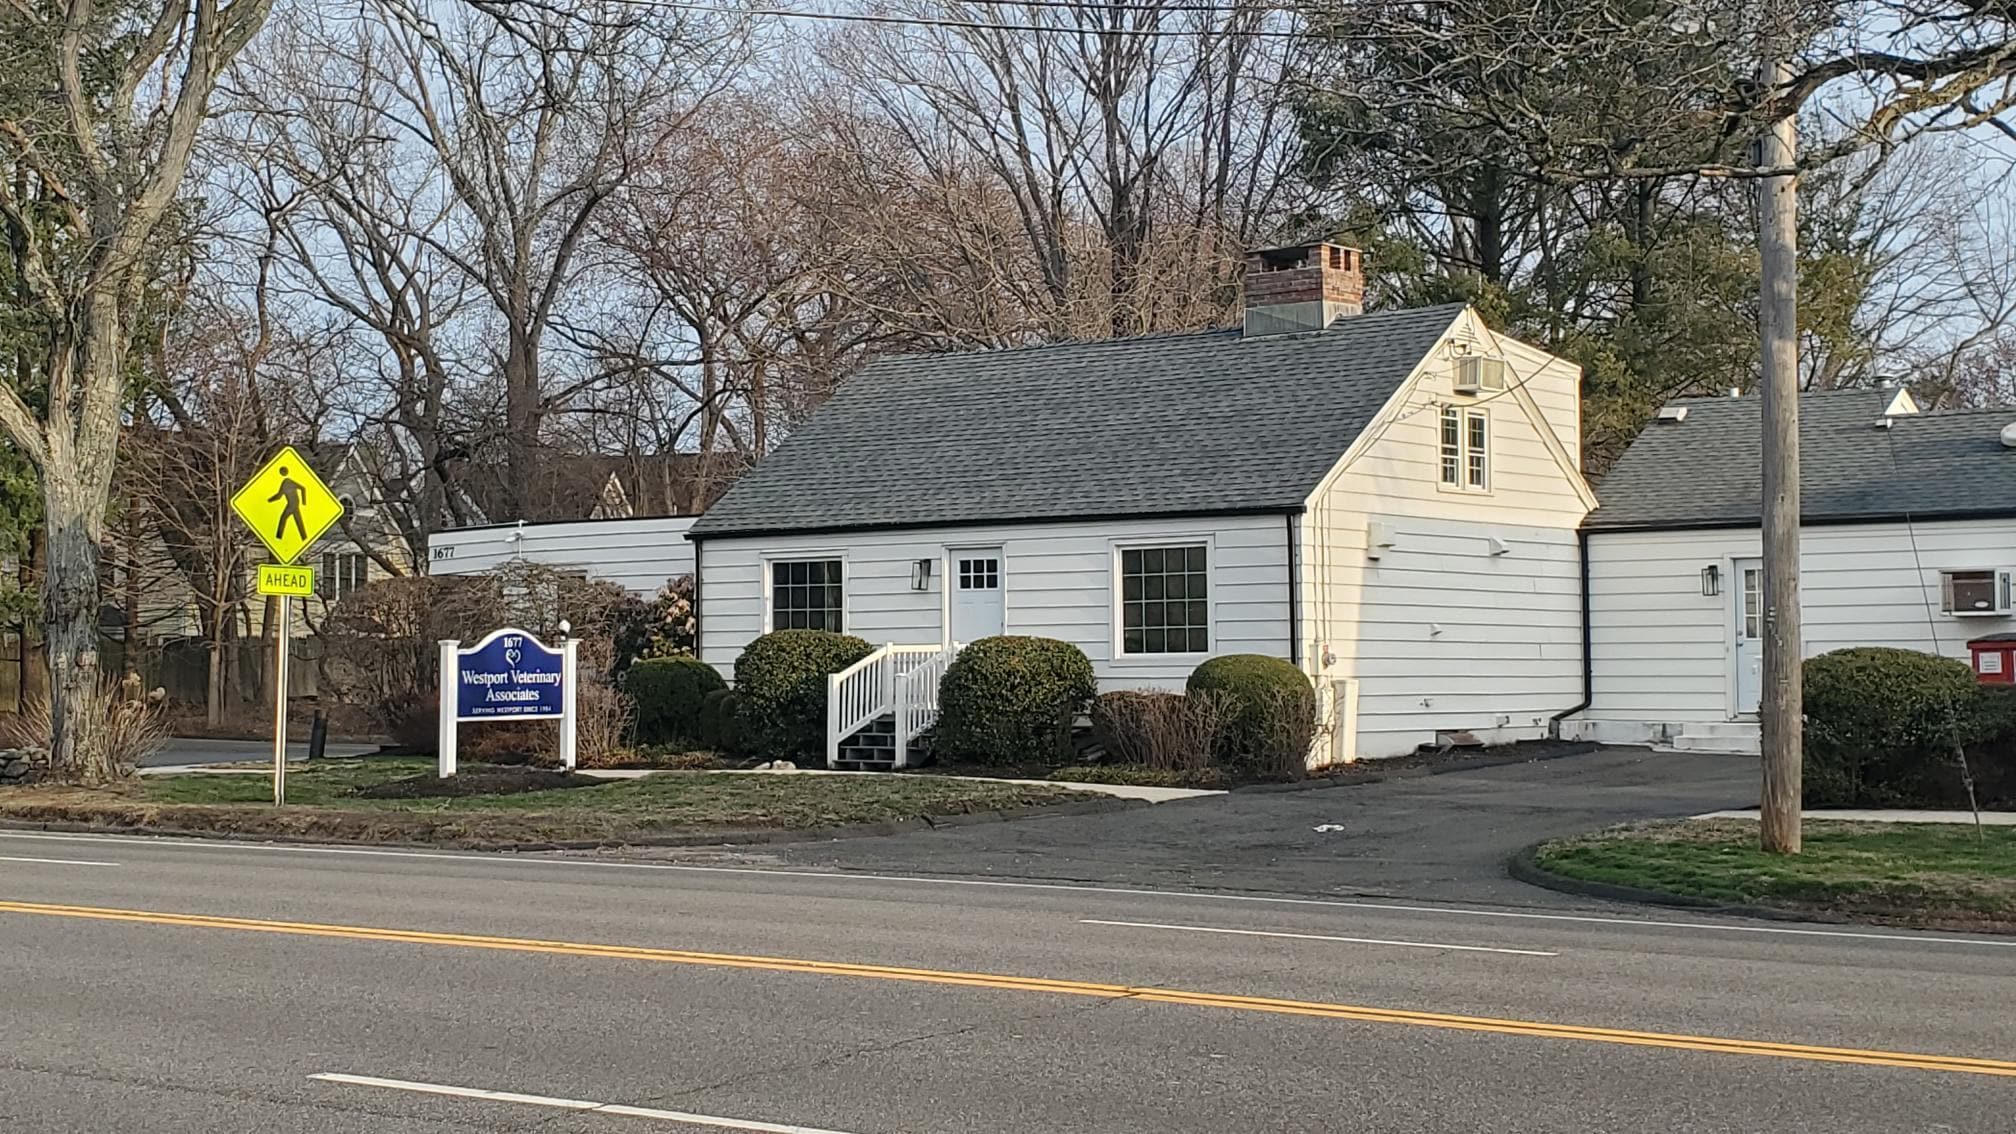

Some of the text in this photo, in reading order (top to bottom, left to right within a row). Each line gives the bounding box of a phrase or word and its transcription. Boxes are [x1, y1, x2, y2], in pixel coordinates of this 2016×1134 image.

[433, 547, 455, 559] 1677
[265, 573, 306, 588] AHEAD
[503, 637, 523, 648] 1677
[462, 669, 562, 688] Westport Veterinary
[485, 687, 540, 702] Associates
